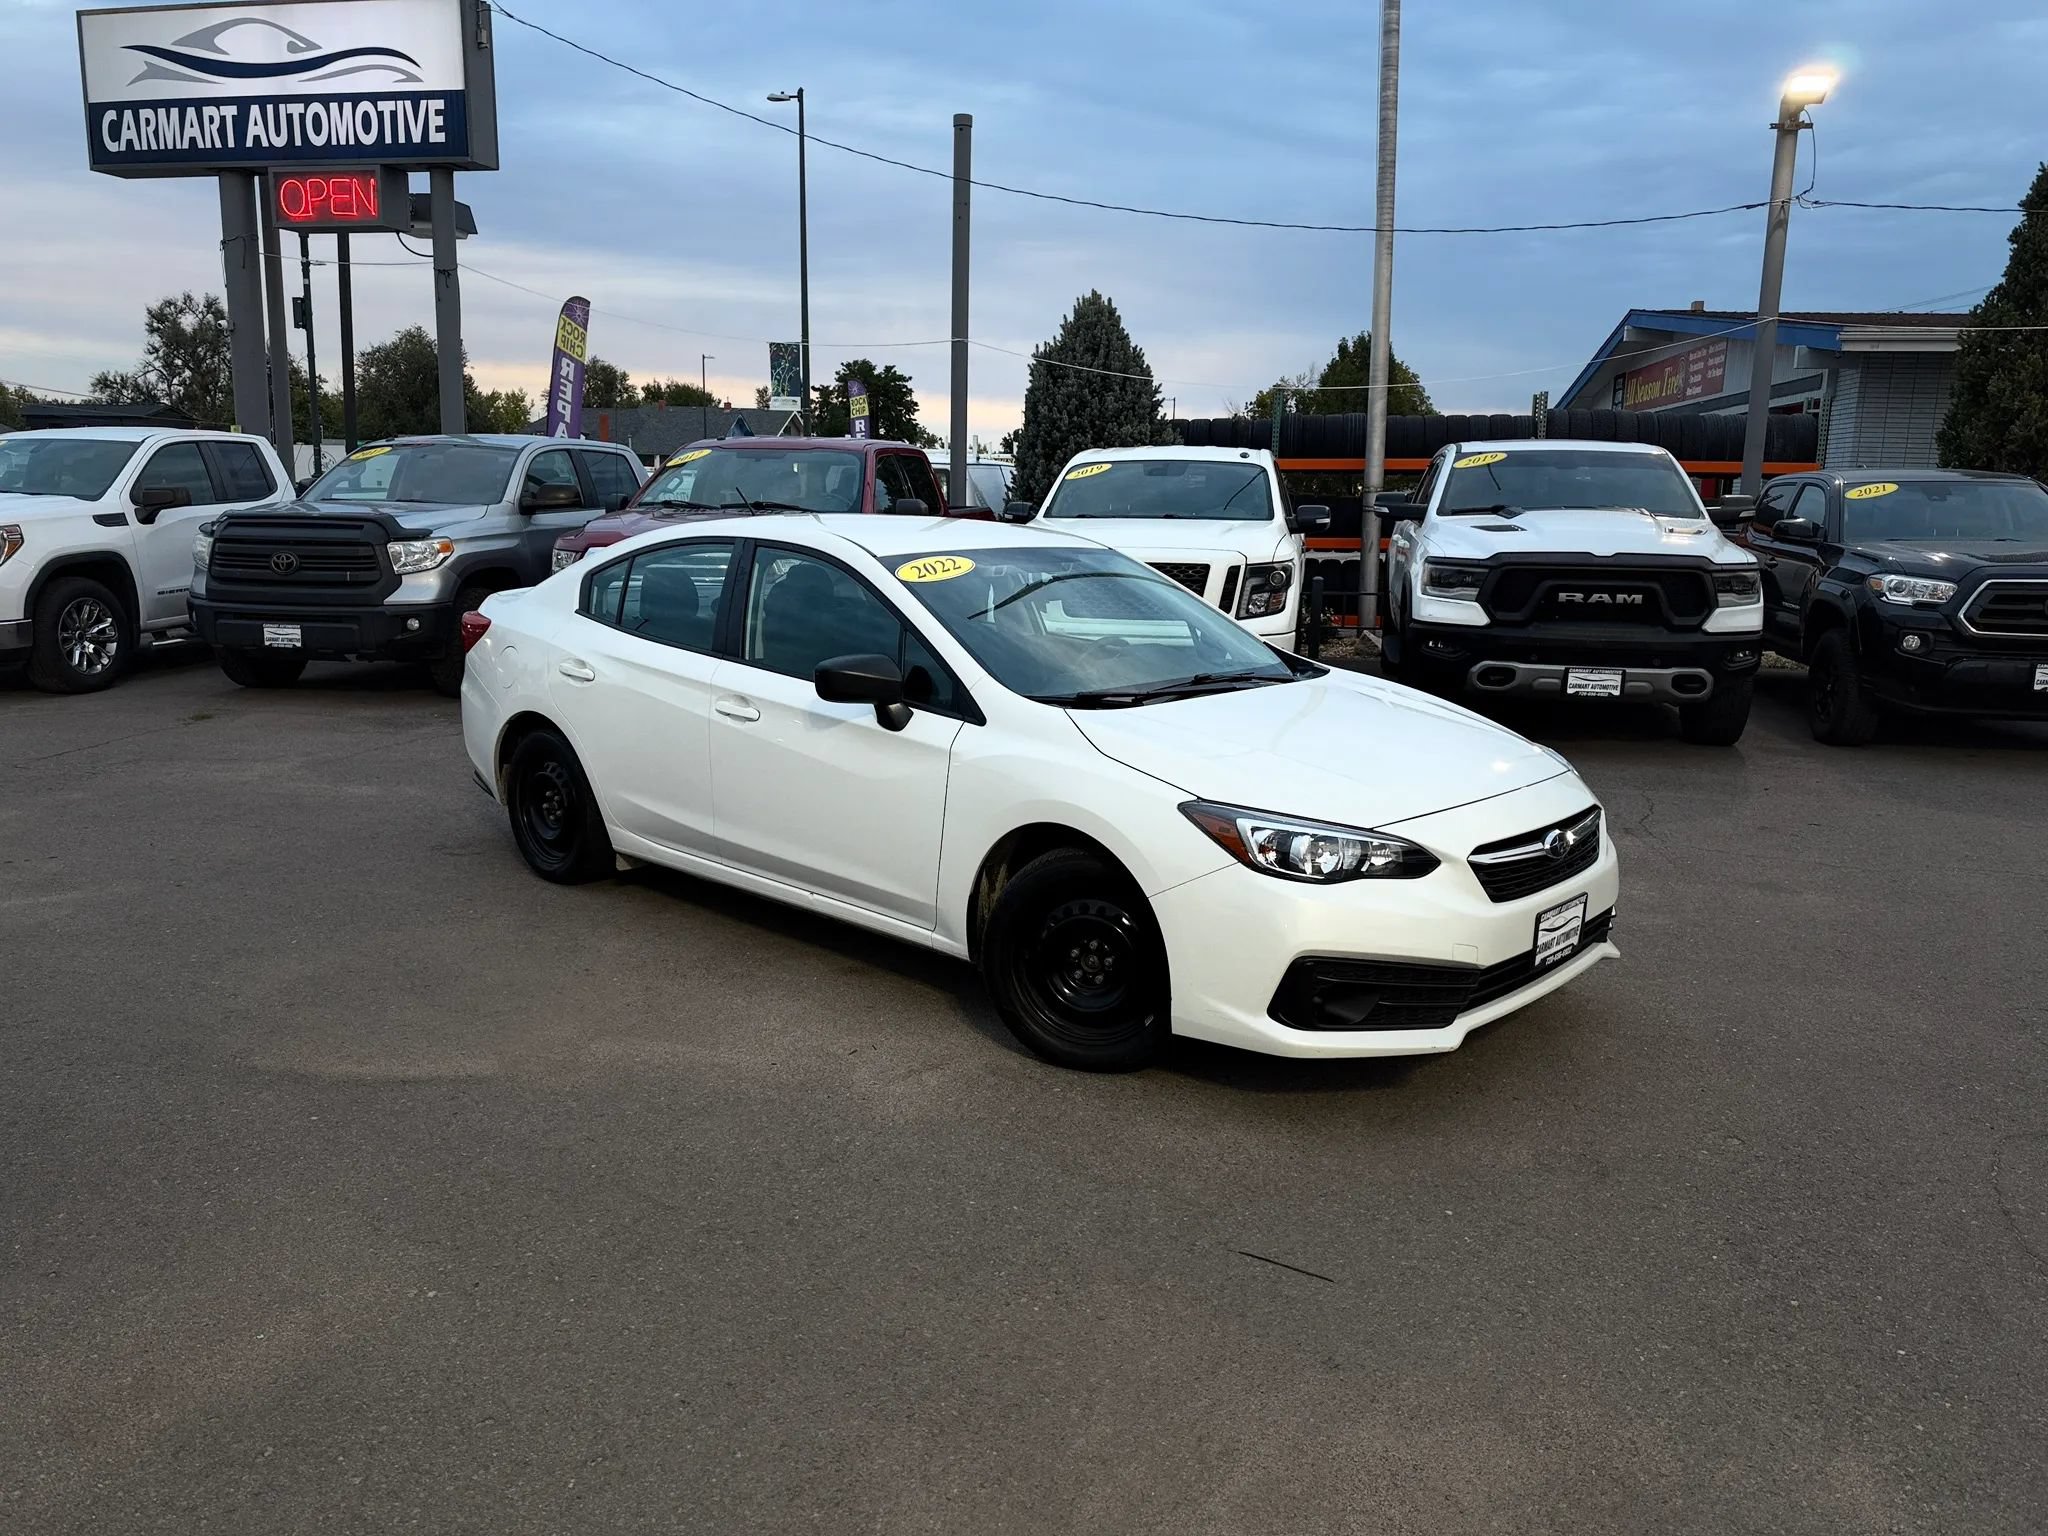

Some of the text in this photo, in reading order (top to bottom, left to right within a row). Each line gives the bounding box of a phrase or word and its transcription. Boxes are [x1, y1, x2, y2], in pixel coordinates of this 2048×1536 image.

[101, 99, 446, 153] CARMART AUTOMOTIVE
[280, 178, 377, 217] OPEN
[1635, 376, 1661, 403] Season
[850, 397, 867, 408] ROCK
[851, 405, 867, 417] CHIP
[1464, 453, 1498, 466] 2019
[1073, 465, 1103, 477] 2019
[1856, 484, 1886, 497] 2021
[910, 558, 962, 579] 2022
[1558, 592, 1643, 604] RAM
[1568, 682, 1619, 691] CARMART AUTOMOTIVE
